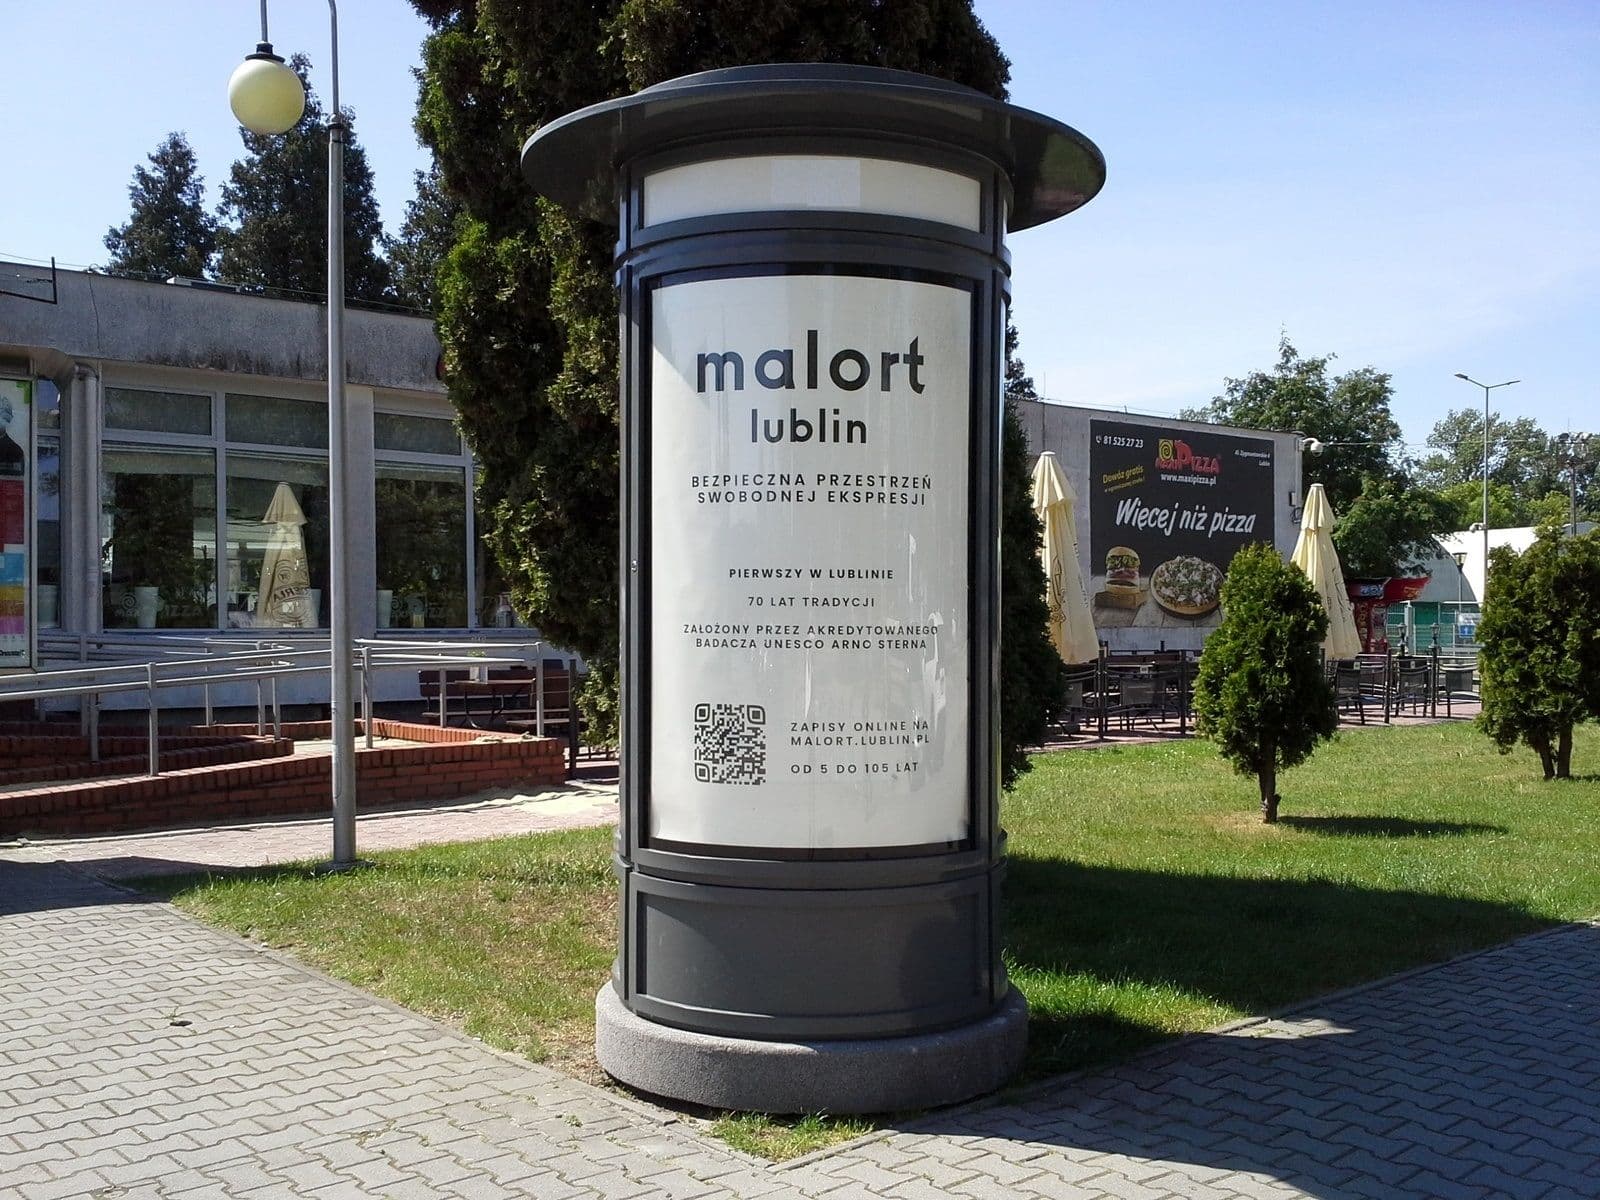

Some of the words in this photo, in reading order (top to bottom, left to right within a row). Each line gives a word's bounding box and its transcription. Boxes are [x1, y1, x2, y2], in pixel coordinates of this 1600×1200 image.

[696, 329, 926, 394] malort
[751, 408, 867, 444] lublin
[1103, 435, 1112, 445] 81
[1112, 436, 1125, 446] 525
[1125, 438, 1135, 447] 27
[1135, 439, 1144, 448] 23
[691, 473, 806, 488] BEZPIECZNA
[817, 473, 932, 490] PRZESTRZEŃ
[697, 490, 817, 504] SWOBODNEJ
[827, 490, 926, 505] EKSPRESJI
[1115, 497, 1179, 536] Więcej
[1179, 505, 1206, 531] niż
[1208, 506, 1256, 538] pizza
[729, 568, 803, 580] PIERWSZY
[809, 569, 823, 579] W
[829, 569, 894, 580] LUBLINIE
[747, 596, 764, 607] 70
[770, 596, 796, 607] LAT
[802, 596, 875, 608] TRADYCJI
[683, 621, 752, 635] ZAŁOŻONY
[756, 624, 800, 635] PRZEZ
[807, 624, 939, 636] AKREDYTOWANEGO
[695, 638, 757, 649] BADACZA
[764, 638, 824, 649] UNESCO
[831, 638, 872, 649] ARNO
[878, 638, 927, 649] STERNA
[790, 722, 846, 732] ZAPISY
[853, 721, 907, 732] ONLINE
[913, 720, 929, 731] NA
[790, 734, 930, 746] MALORT.LUBLIN.PL
[790, 764, 812, 774] OD
[820, 764, 828, 774] 5
[836, 763, 858, 774] DO
[865, 763, 889, 774] 105
[896, 762, 918, 773] LAT
